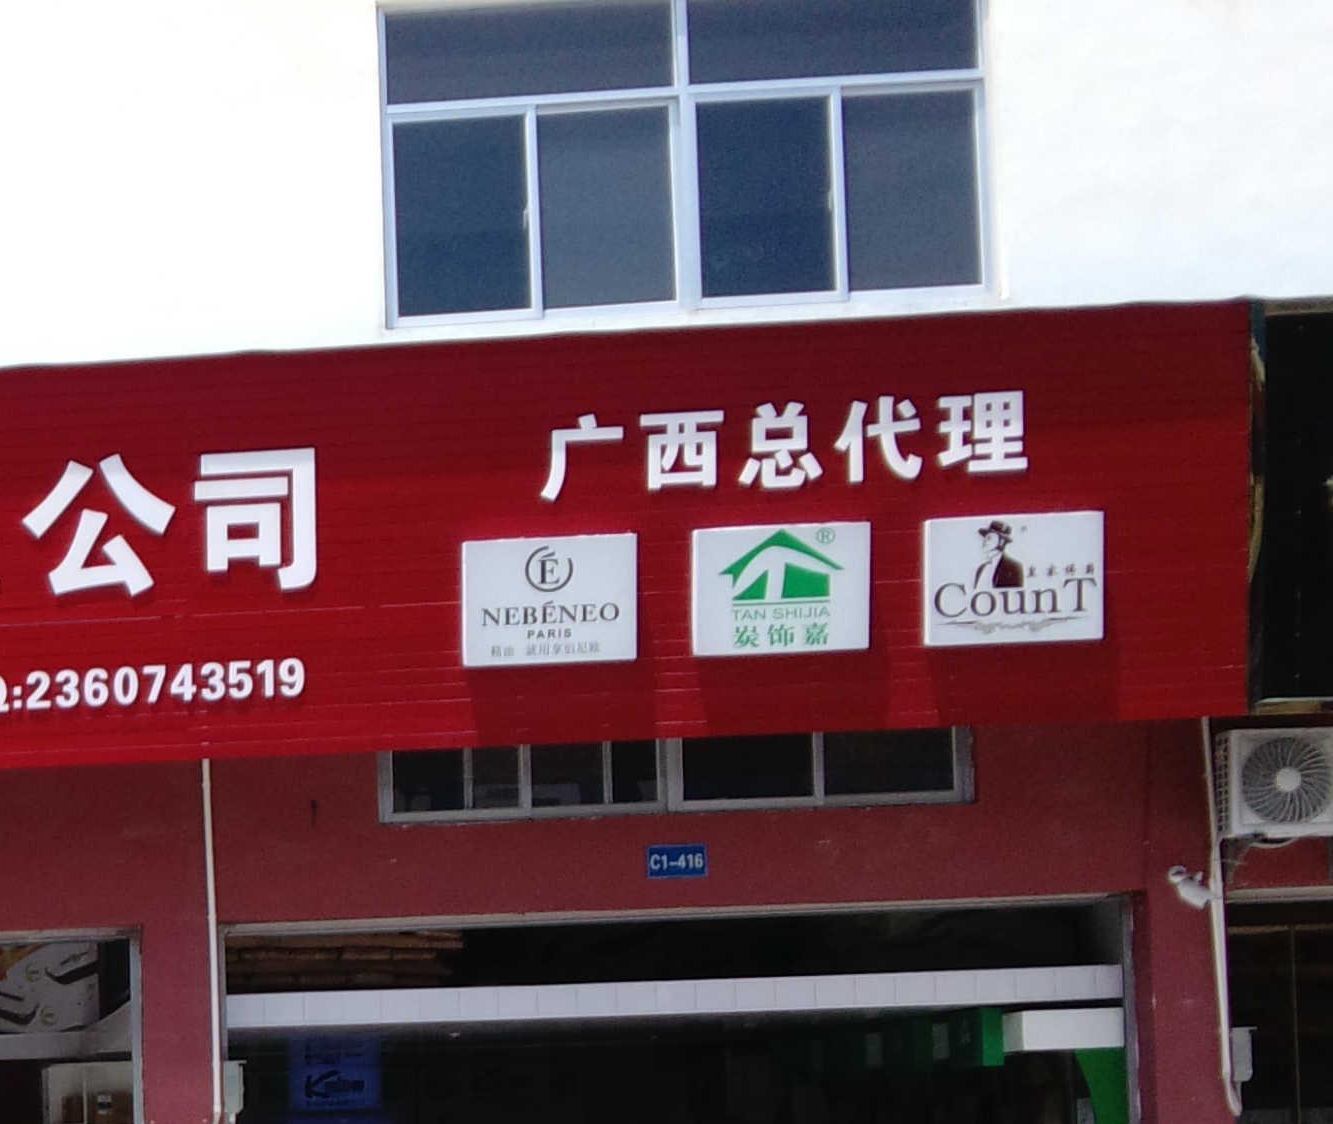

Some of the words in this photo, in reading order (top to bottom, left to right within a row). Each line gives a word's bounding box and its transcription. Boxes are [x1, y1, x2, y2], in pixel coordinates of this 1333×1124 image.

[540, 390, 1029, 501] 广西总代理
[481, 600, 620, 627] NEBÉNEO
[733, 608, 766, 620] TAN
[772, 606, 831, 620] SHIJIA
[527, 628, 572, 640] PARIS
[650, 853, 703, 870] C1-416
